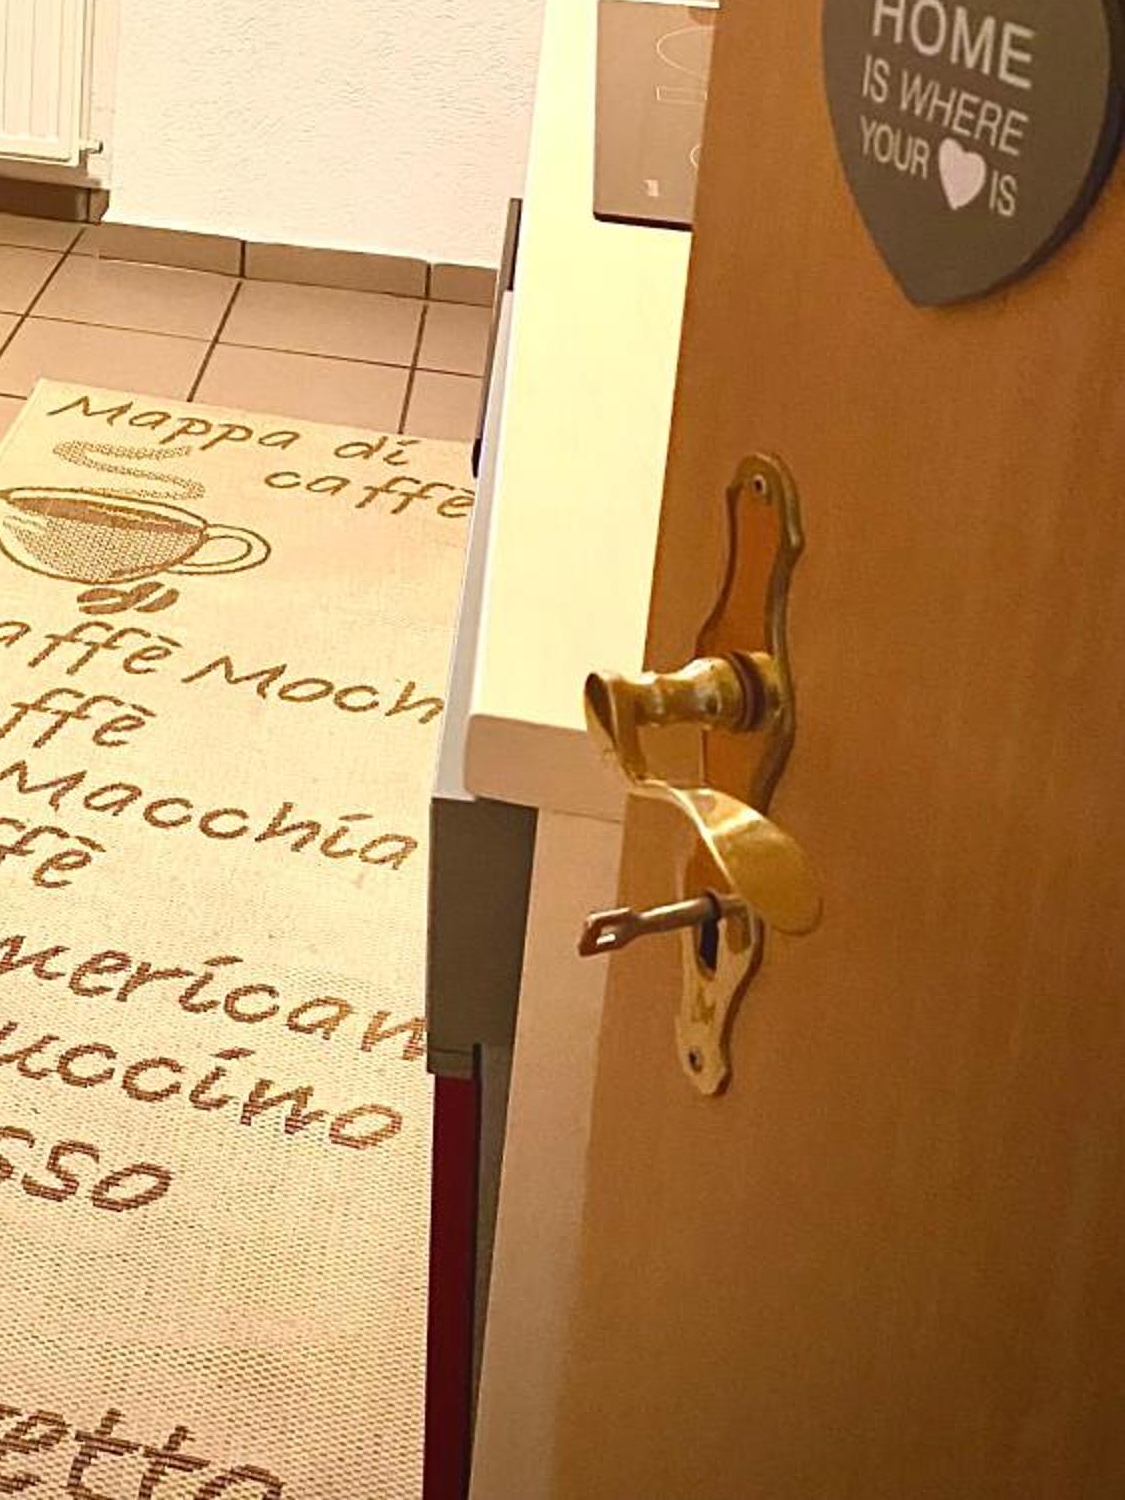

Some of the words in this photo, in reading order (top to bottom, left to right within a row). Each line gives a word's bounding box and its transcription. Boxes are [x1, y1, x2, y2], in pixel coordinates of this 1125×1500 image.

[862, 54, 890, 103] IS
[899, 70, 1030, 157] WHERE
[859, 115, 931, 180] YOUR
[988, 172, 1018, 218] IS
[48, 395, 302, 451] Mappa
[334, 435, 422, 466] di
